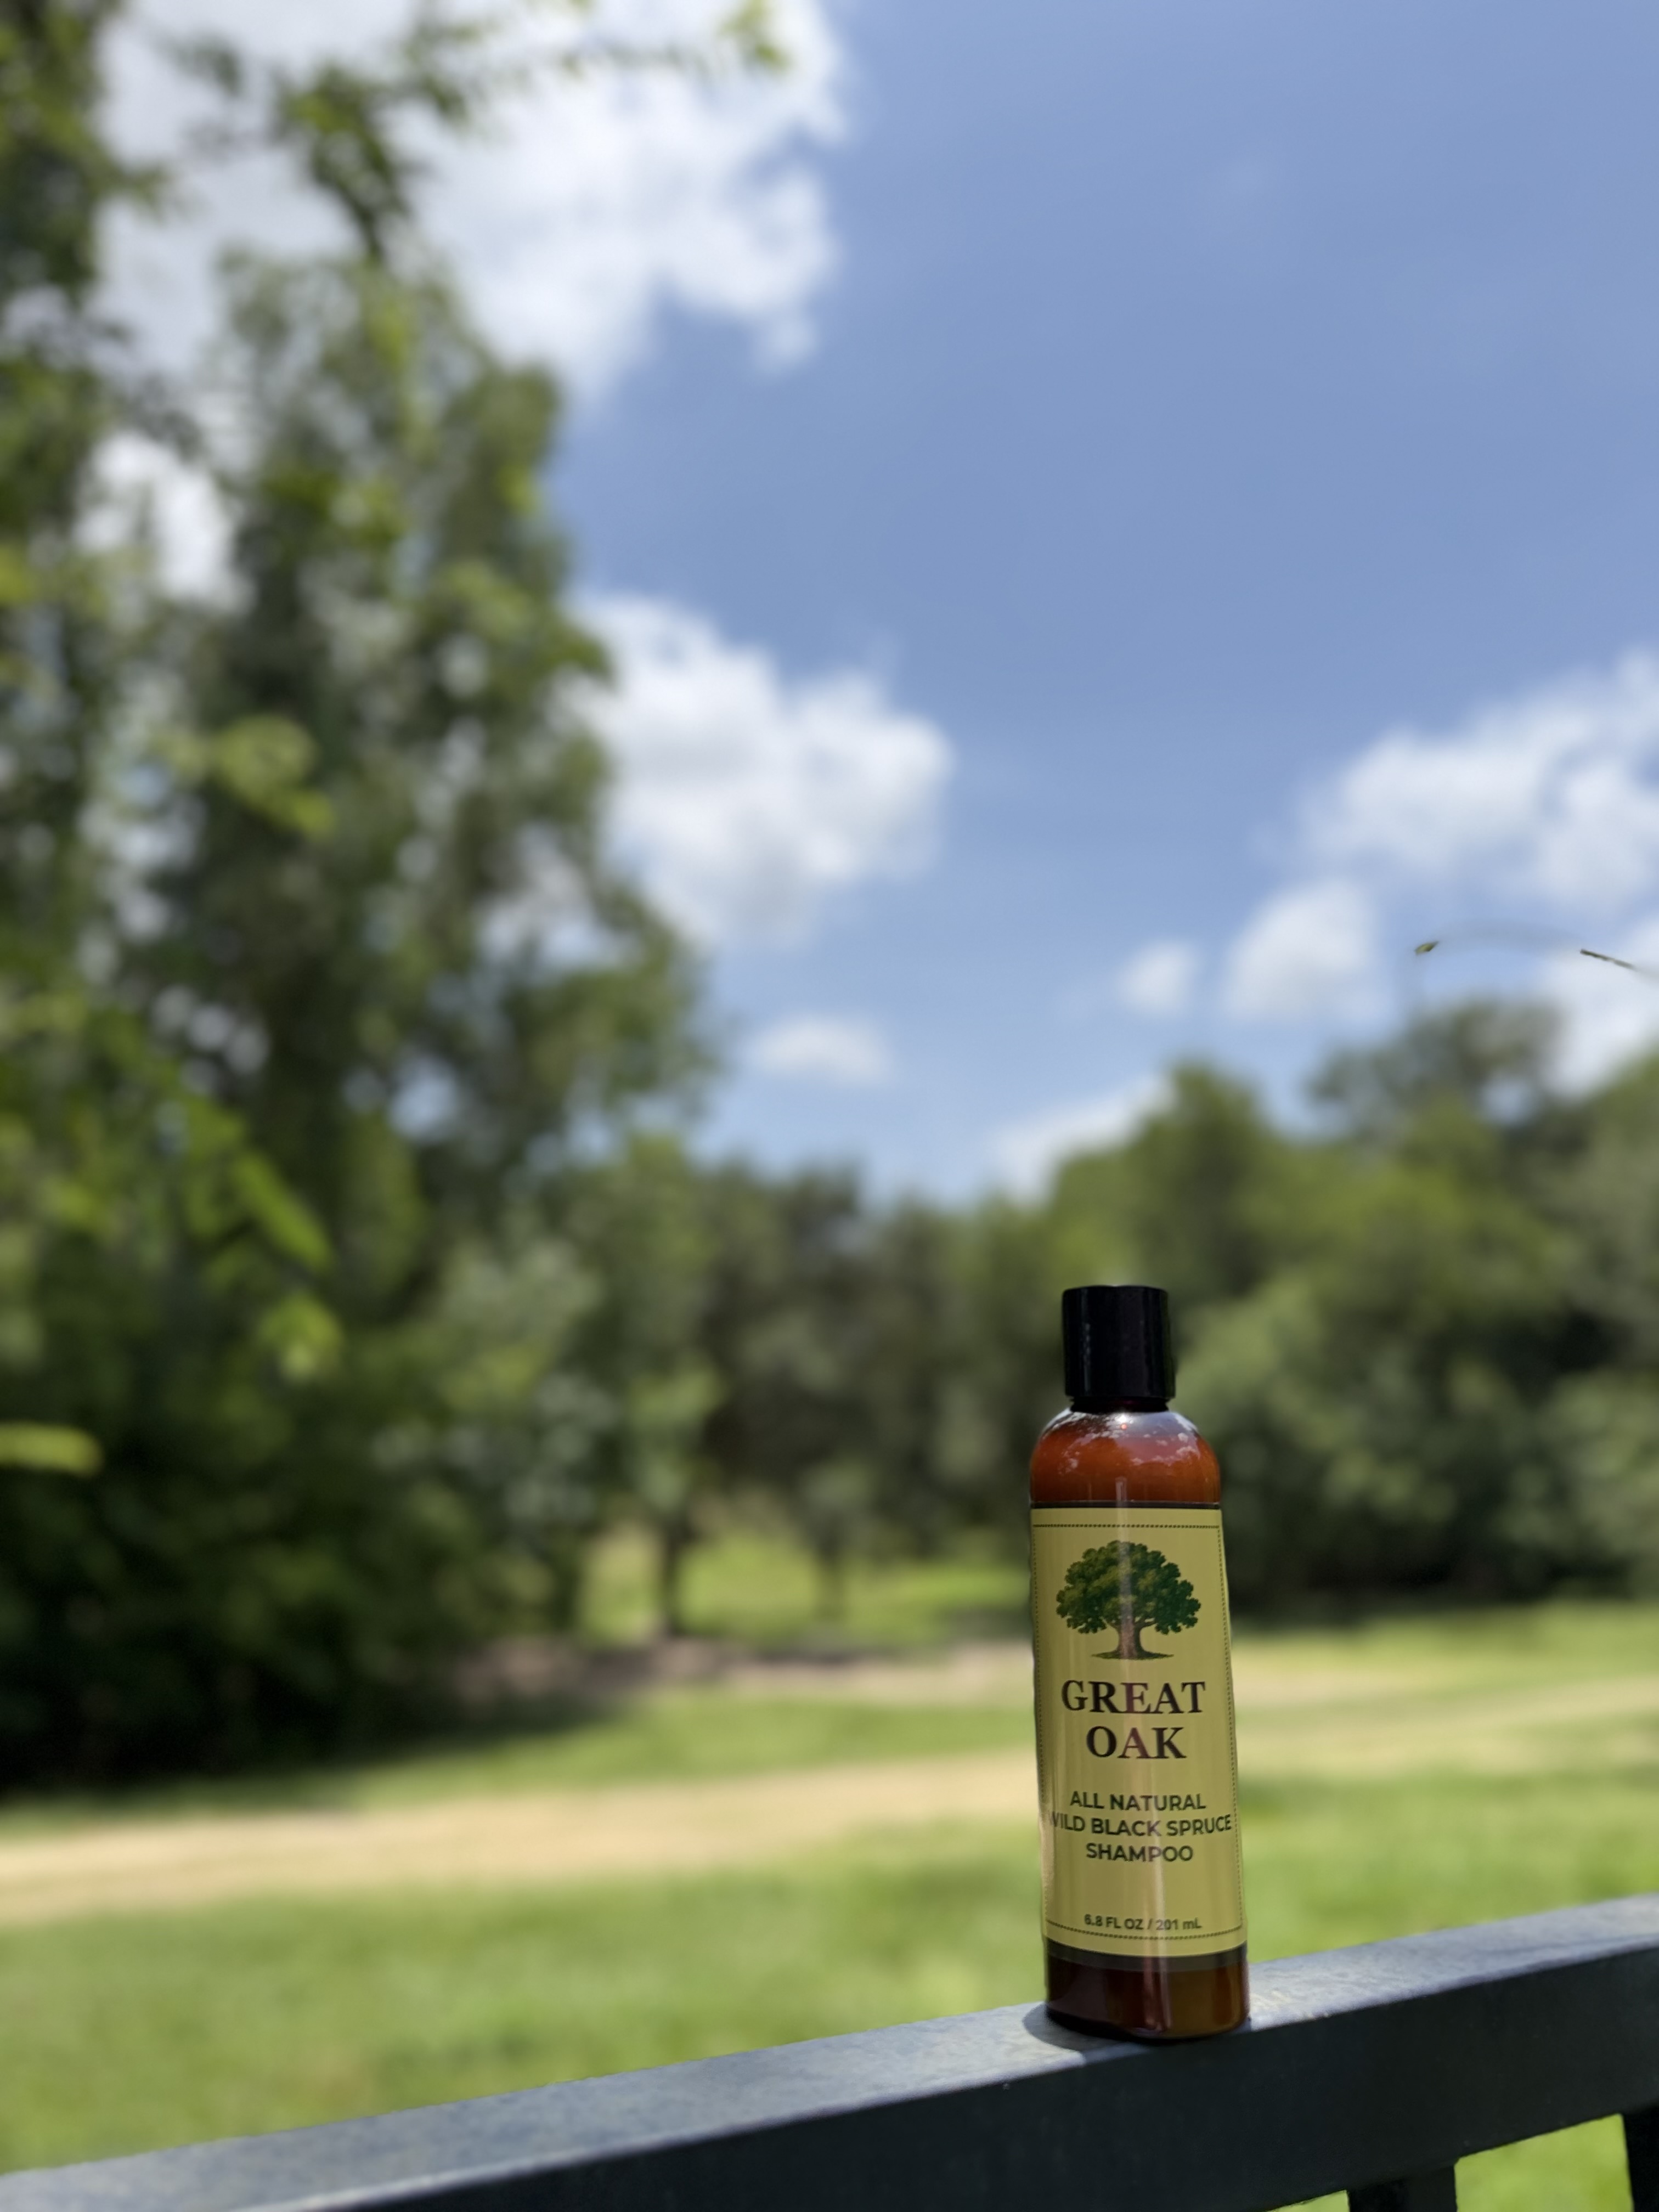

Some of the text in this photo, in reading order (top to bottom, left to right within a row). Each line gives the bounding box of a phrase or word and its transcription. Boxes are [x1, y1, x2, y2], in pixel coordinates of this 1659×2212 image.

[1061, 1679, 1206, 1714] GREAT
[1086, 1726, 1187, 1759] OAK
[1070, 1791, 1206, 1811] ALL NATURAL
[1091, 1818, 1161, 1837] BLACK
[1166, 1814, 1232, 1836] SPRUCE
[1086, 1842, 1193, 1862] SHAMPOO
[1084, 1914, 1103, 1926] 6.8
[1105, 1917, 1121, 1928] FL
[1125, 1918, 1143, 1930] OZ
[1156, 1918, 1179, 1930] 201
[1183, 1917, 1201, 1929] mL
